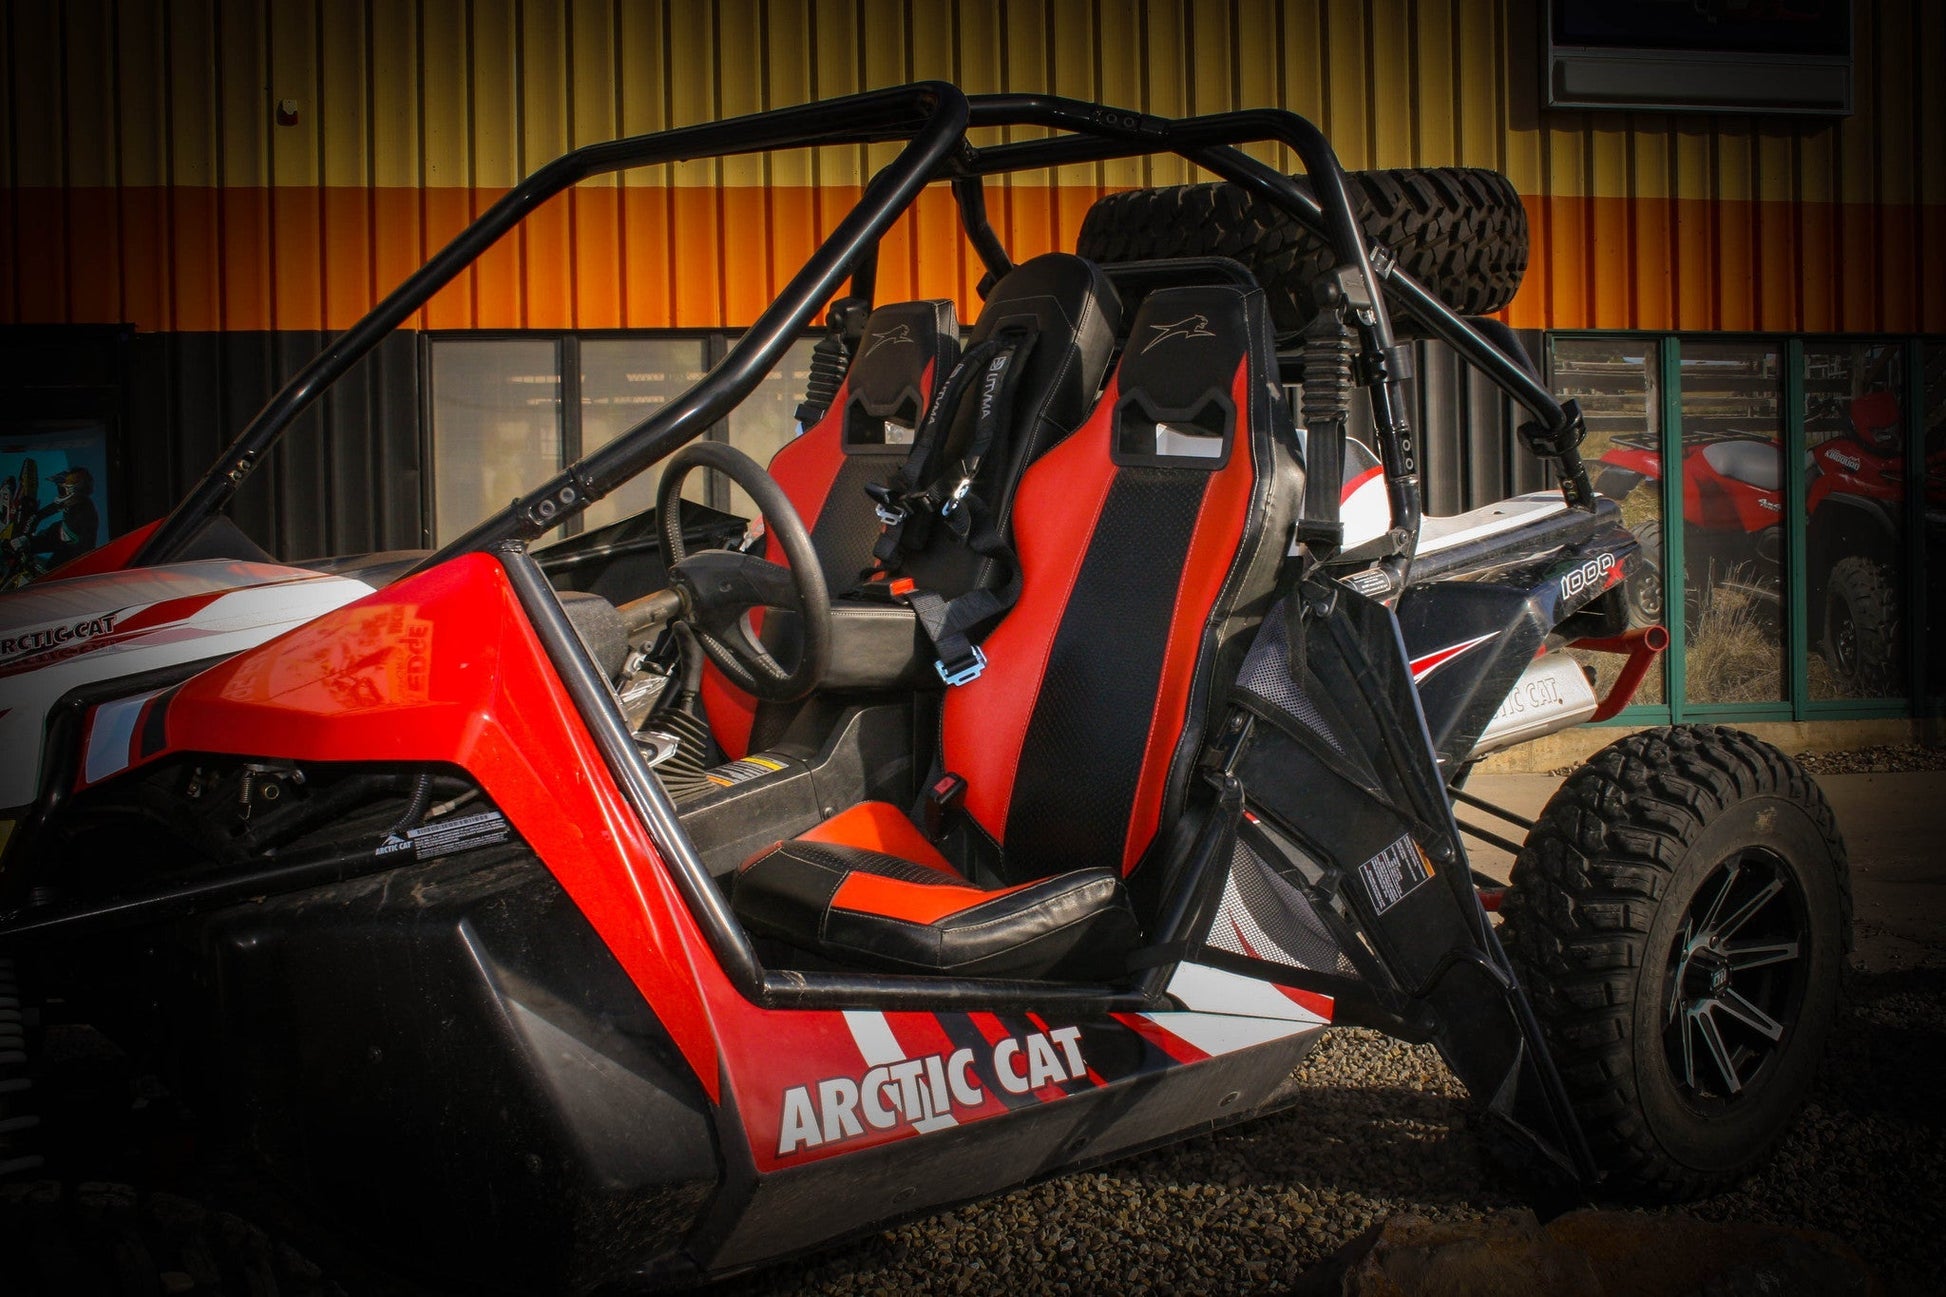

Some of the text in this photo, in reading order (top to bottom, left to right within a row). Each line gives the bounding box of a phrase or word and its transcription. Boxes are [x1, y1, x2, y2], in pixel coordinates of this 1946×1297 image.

[981, 372, 999, 420] UTVMA
[74, 616, 116, 638] CAT
[375, 839, 413, 856] ARCTIC CAT
[777, 1025, 1087, 1156] ARCTIC CAT
